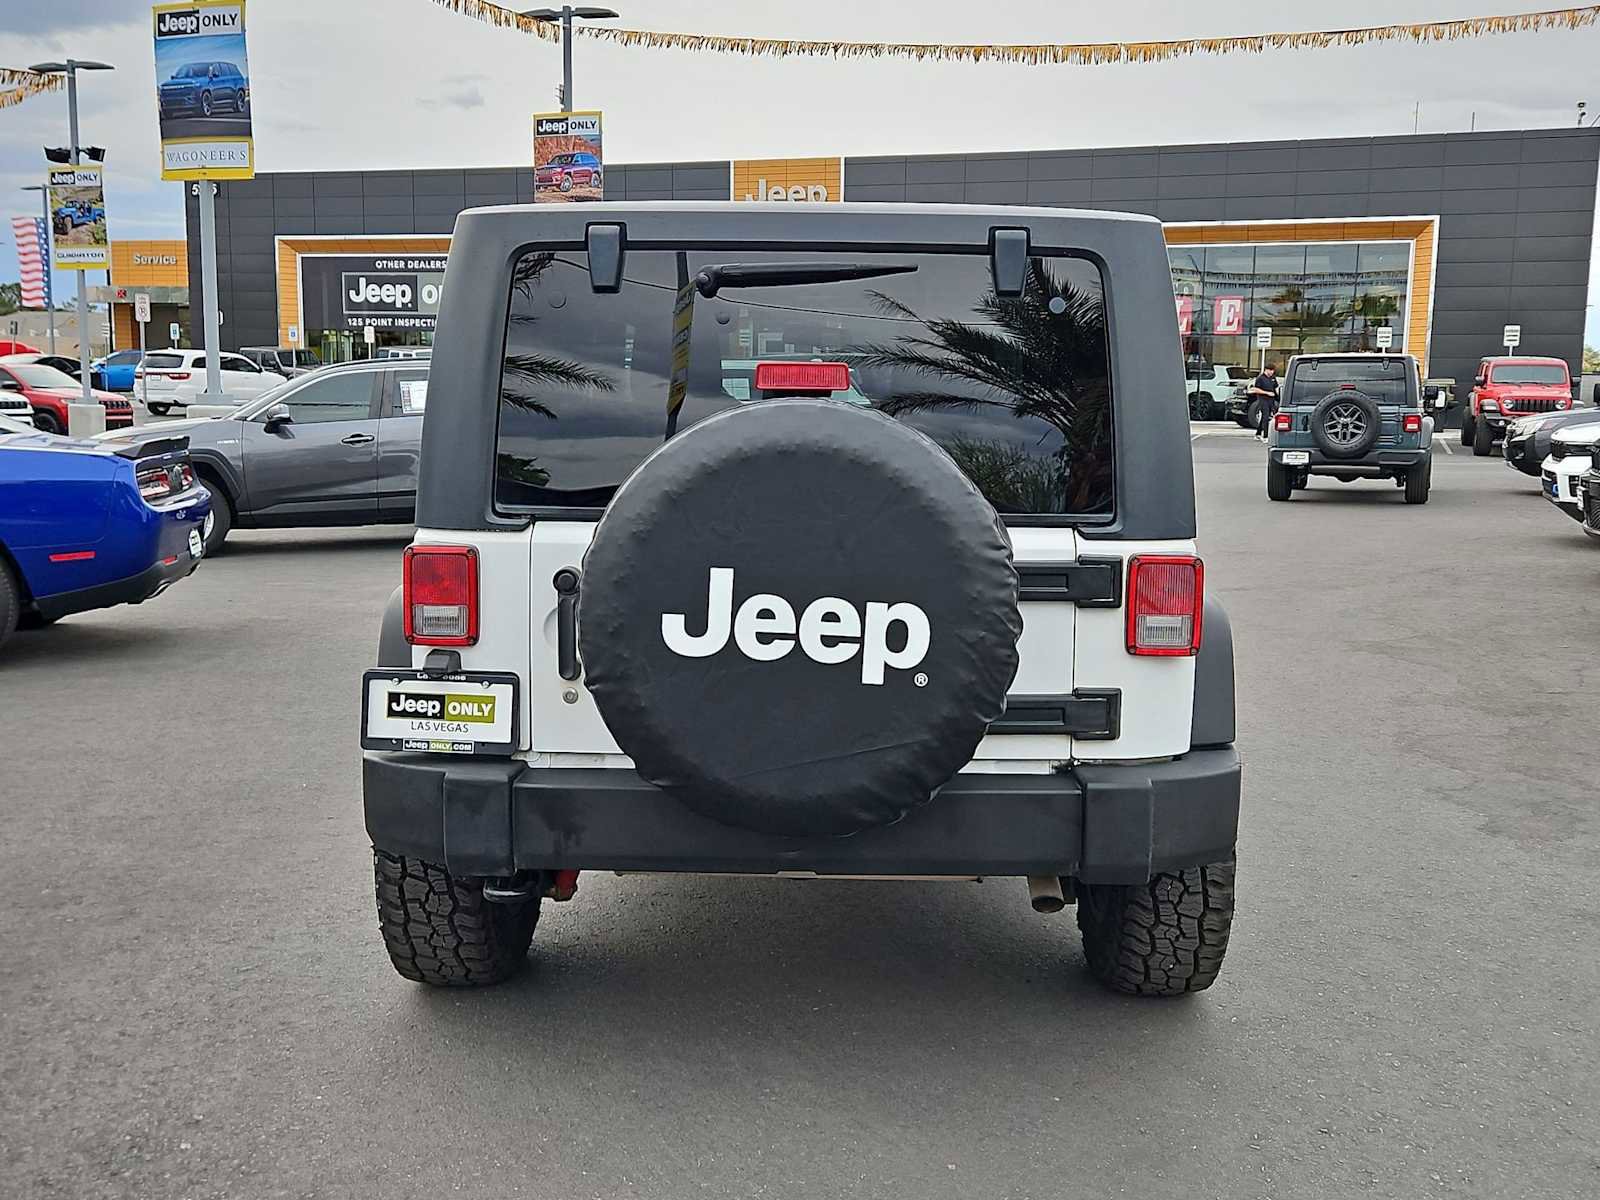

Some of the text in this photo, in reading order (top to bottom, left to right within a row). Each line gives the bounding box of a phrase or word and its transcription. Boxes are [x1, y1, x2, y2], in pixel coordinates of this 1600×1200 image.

[159, 13, 238, 33] Jeep ONLY
[538, 119, 597, 134] Jeep ONLY
[166, 150, 247, 162] WAGONEER S
[52, 172, 98, 185] Jeep ONLY
[745, 178, 828, 202] Jeep
[133, 253, 177, 265] Service
[375, 260, 447, 269] OTHER DEALERS
[348, 277, 412, 308] Jeep
[347, 318, 437, 327] 125 POINT INSPECTI
[1216, 299, 1242, 331] E
[661, 566, 931, 686] Jeep
[391, 694, 493, 717] Jeep ONLY
[410, 720, 469, 733] LAS VEGAS
